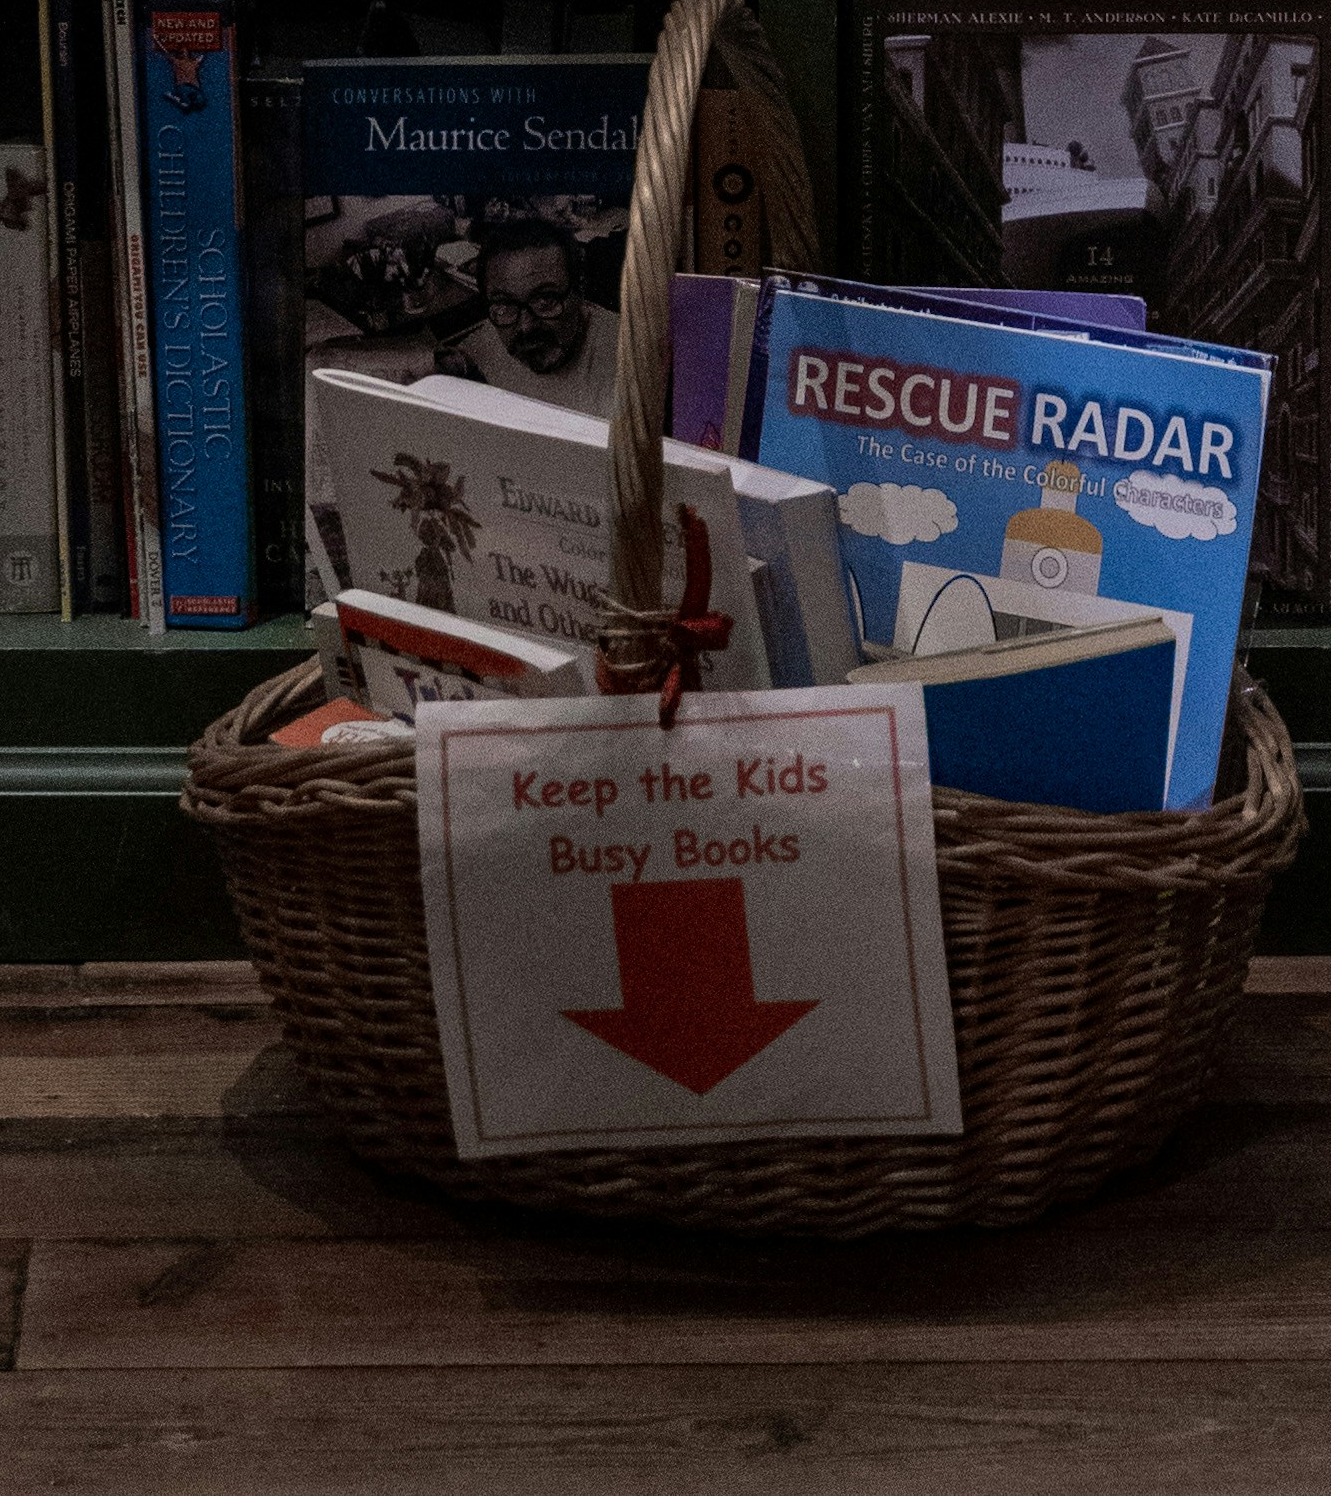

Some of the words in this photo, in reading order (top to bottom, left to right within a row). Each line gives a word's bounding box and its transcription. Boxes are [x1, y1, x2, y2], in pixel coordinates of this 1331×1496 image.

[332, 87, 480, 105] CONVERSATIONS
[491, 87, 537, 105] WITH
[364, 117, 511, 153] Maurice
[156, 124, 191, 332] CHILDREN'S
[195, 227, 233, 461] SCHOLASTIC
[164, 344, 198, 566] DICTIONARY
[795, 355, 1015, 441] RESCUE
[1031, 392, 1234, 479] RADAR
[857, 435, 893, 460] The
[901, 443, 947, 469] Case
[954, 452, 976, 474] of
[982, 458, 1016, 480] the
[1023, 464, 1107, 498] Colorful
[1112, 478, 1224, 520] Characters
[513, 772, 617, 817] Keep
[640, 763, 713, 802] the
[737, 755, 828, 799] Kids
[550, 836, 651, 881] Busy
[674, 824, 799, 868] Books
